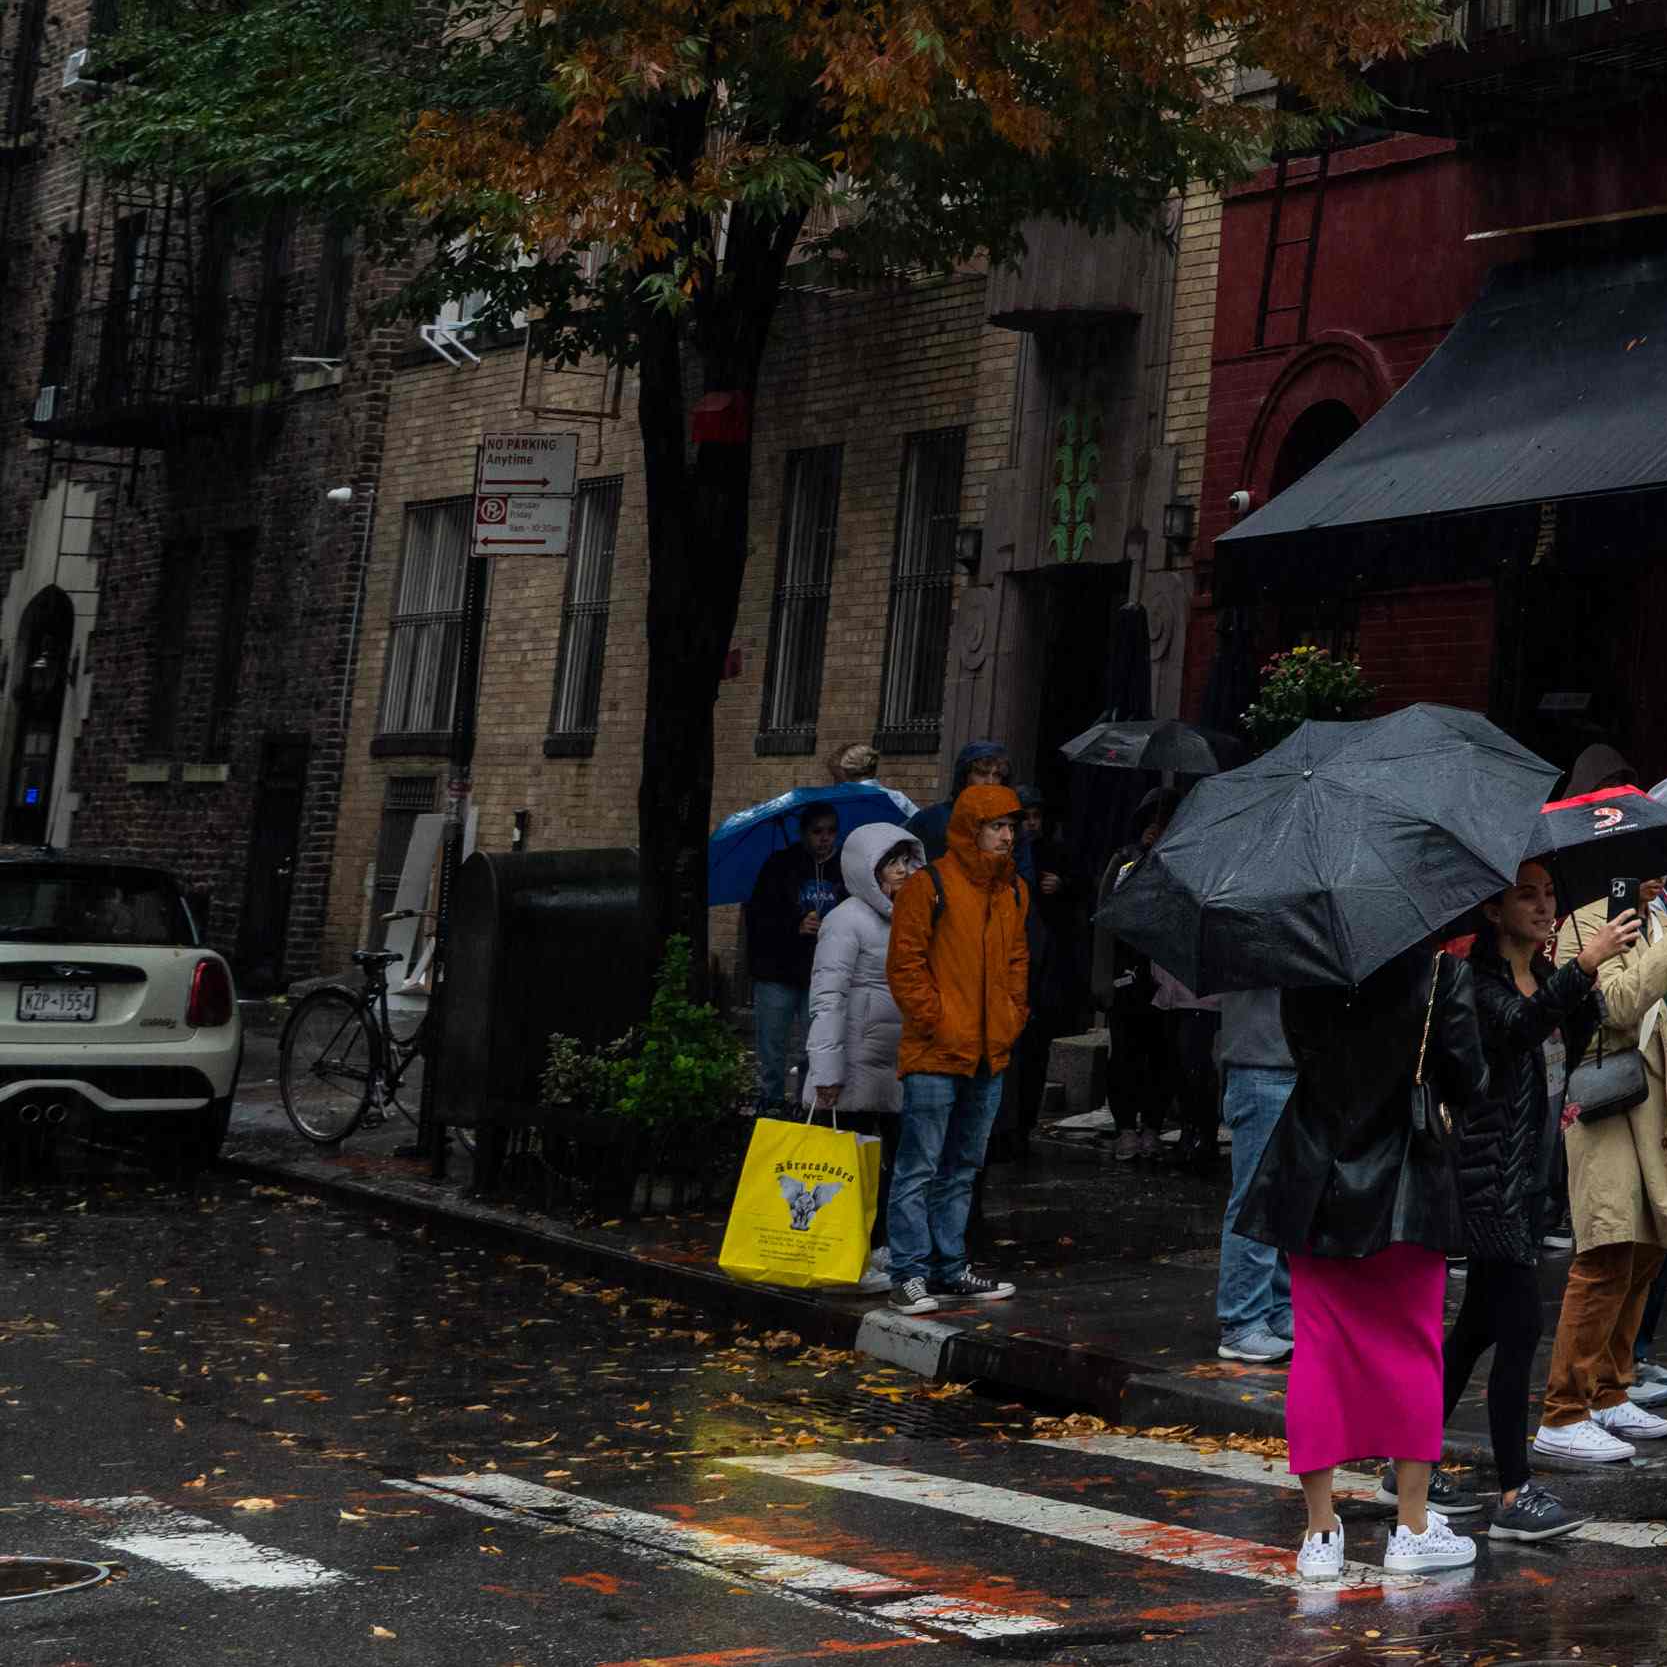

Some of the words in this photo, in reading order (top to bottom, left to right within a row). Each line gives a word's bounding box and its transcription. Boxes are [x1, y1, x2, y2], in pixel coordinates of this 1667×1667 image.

[486, 439, 503, 450] NO
[506, 439, 558, 451] PARKING
[486, 453, 534, 467] Anytime
[774, 1161, 856, 1182] Abracadabra
